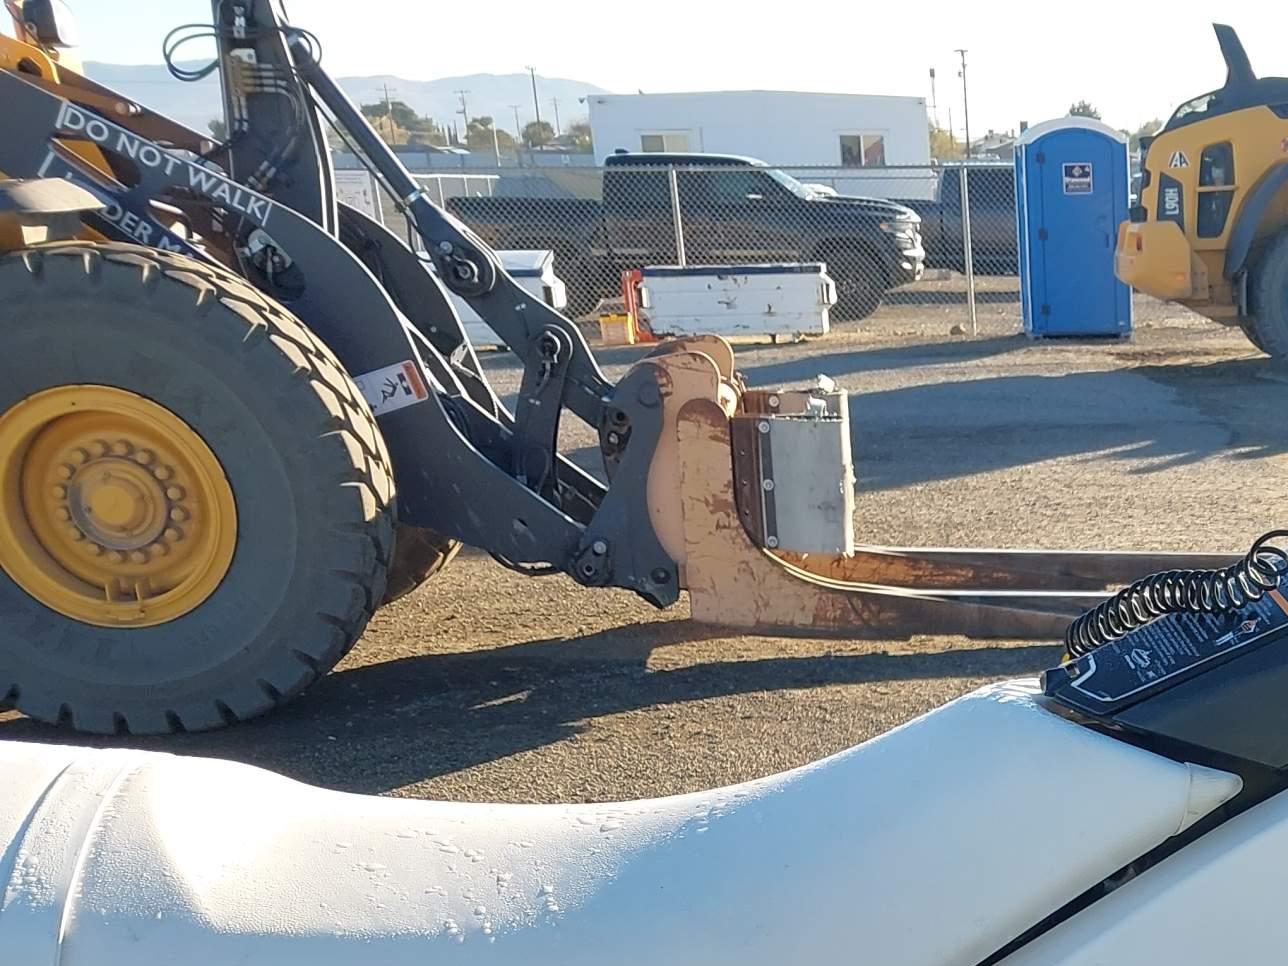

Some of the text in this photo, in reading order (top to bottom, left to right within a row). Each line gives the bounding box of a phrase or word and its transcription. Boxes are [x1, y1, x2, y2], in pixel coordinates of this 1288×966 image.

[63, 106, 268, 219] DO NOT WALK
[1164, 187, 1180, 215] L90H
